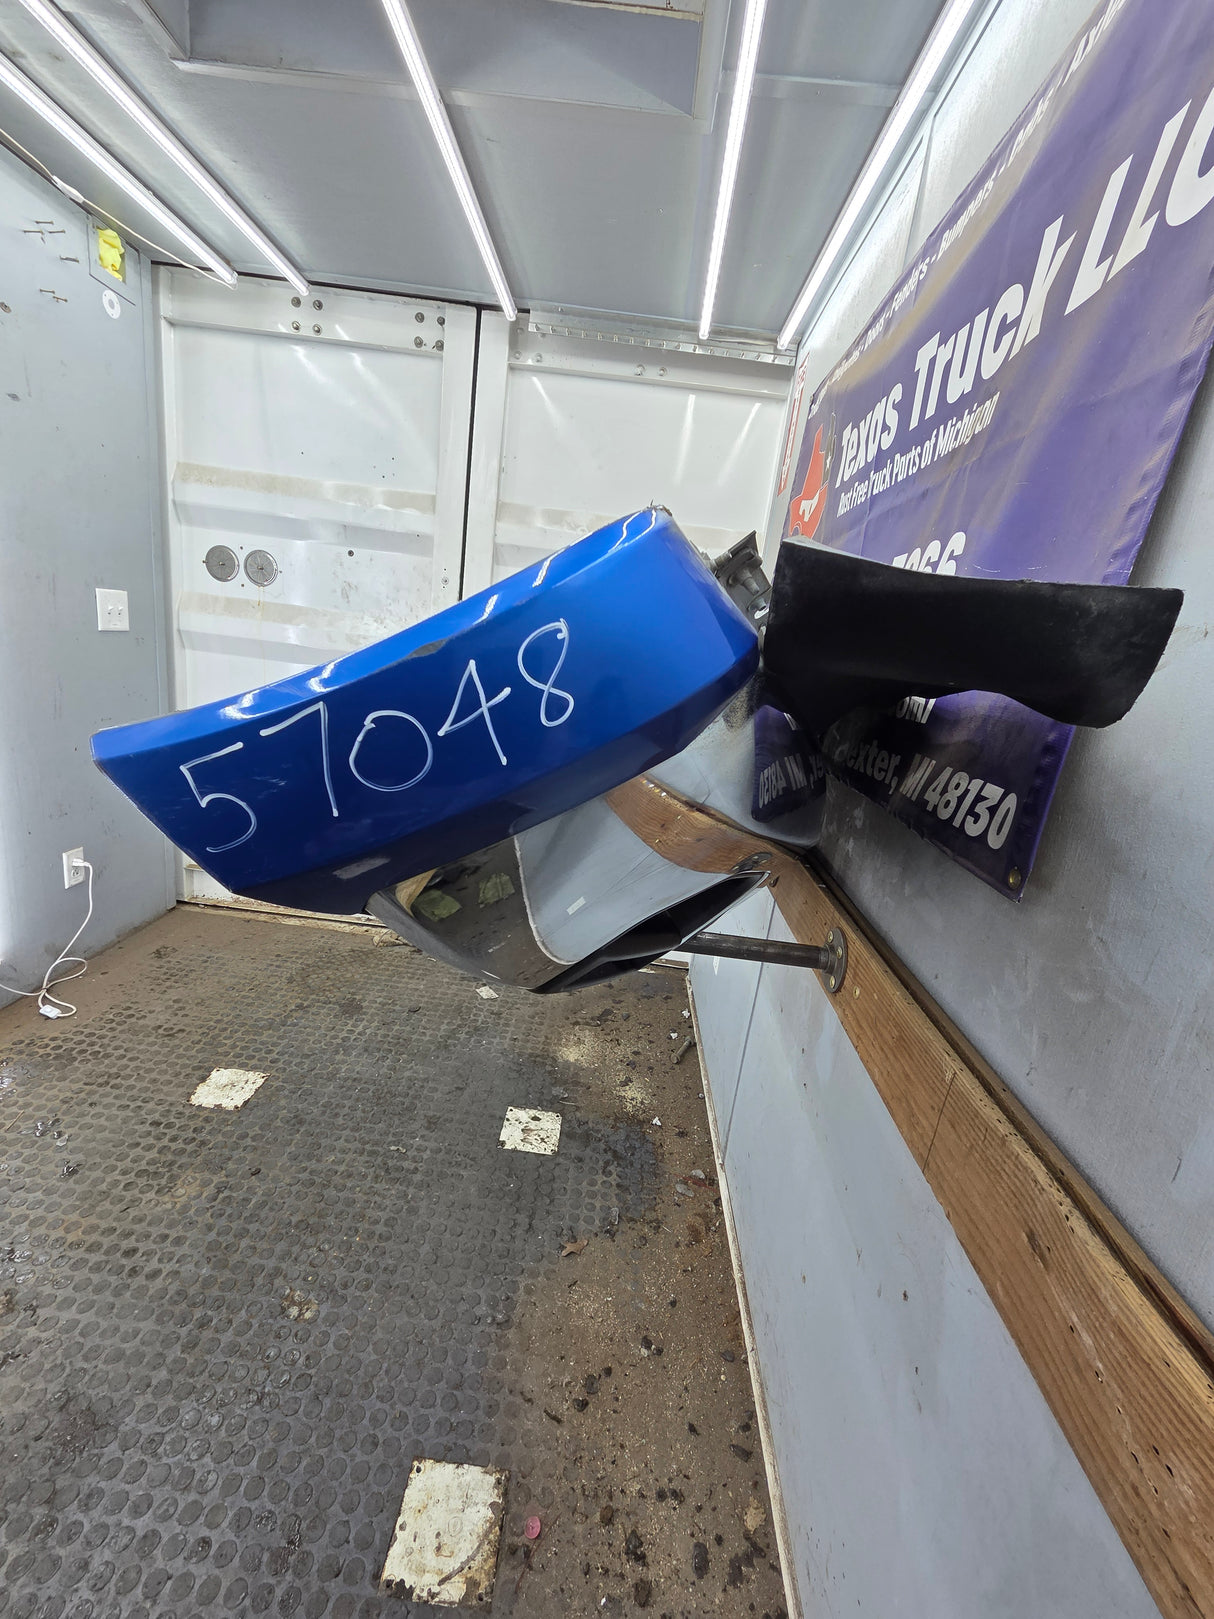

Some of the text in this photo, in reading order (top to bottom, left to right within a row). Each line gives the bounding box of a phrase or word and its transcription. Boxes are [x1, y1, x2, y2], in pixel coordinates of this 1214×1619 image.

[889, 256, 930, 318] Fenders
[936, 177, 994, 261] Bumpers
[835, 383, 902, 488] Texas
[909, 214, 1078, 431] Truck
[837, 391, 1000, 518] Rust Free Truck Parts of Michigan
[892, 531, 967, 575] 66
[180, 618, 575, 852] 57048
[846, 739, 901, 795] exter,
[900, 753, 936, 801] MI
[924, 766, 1018, 850] 48130
